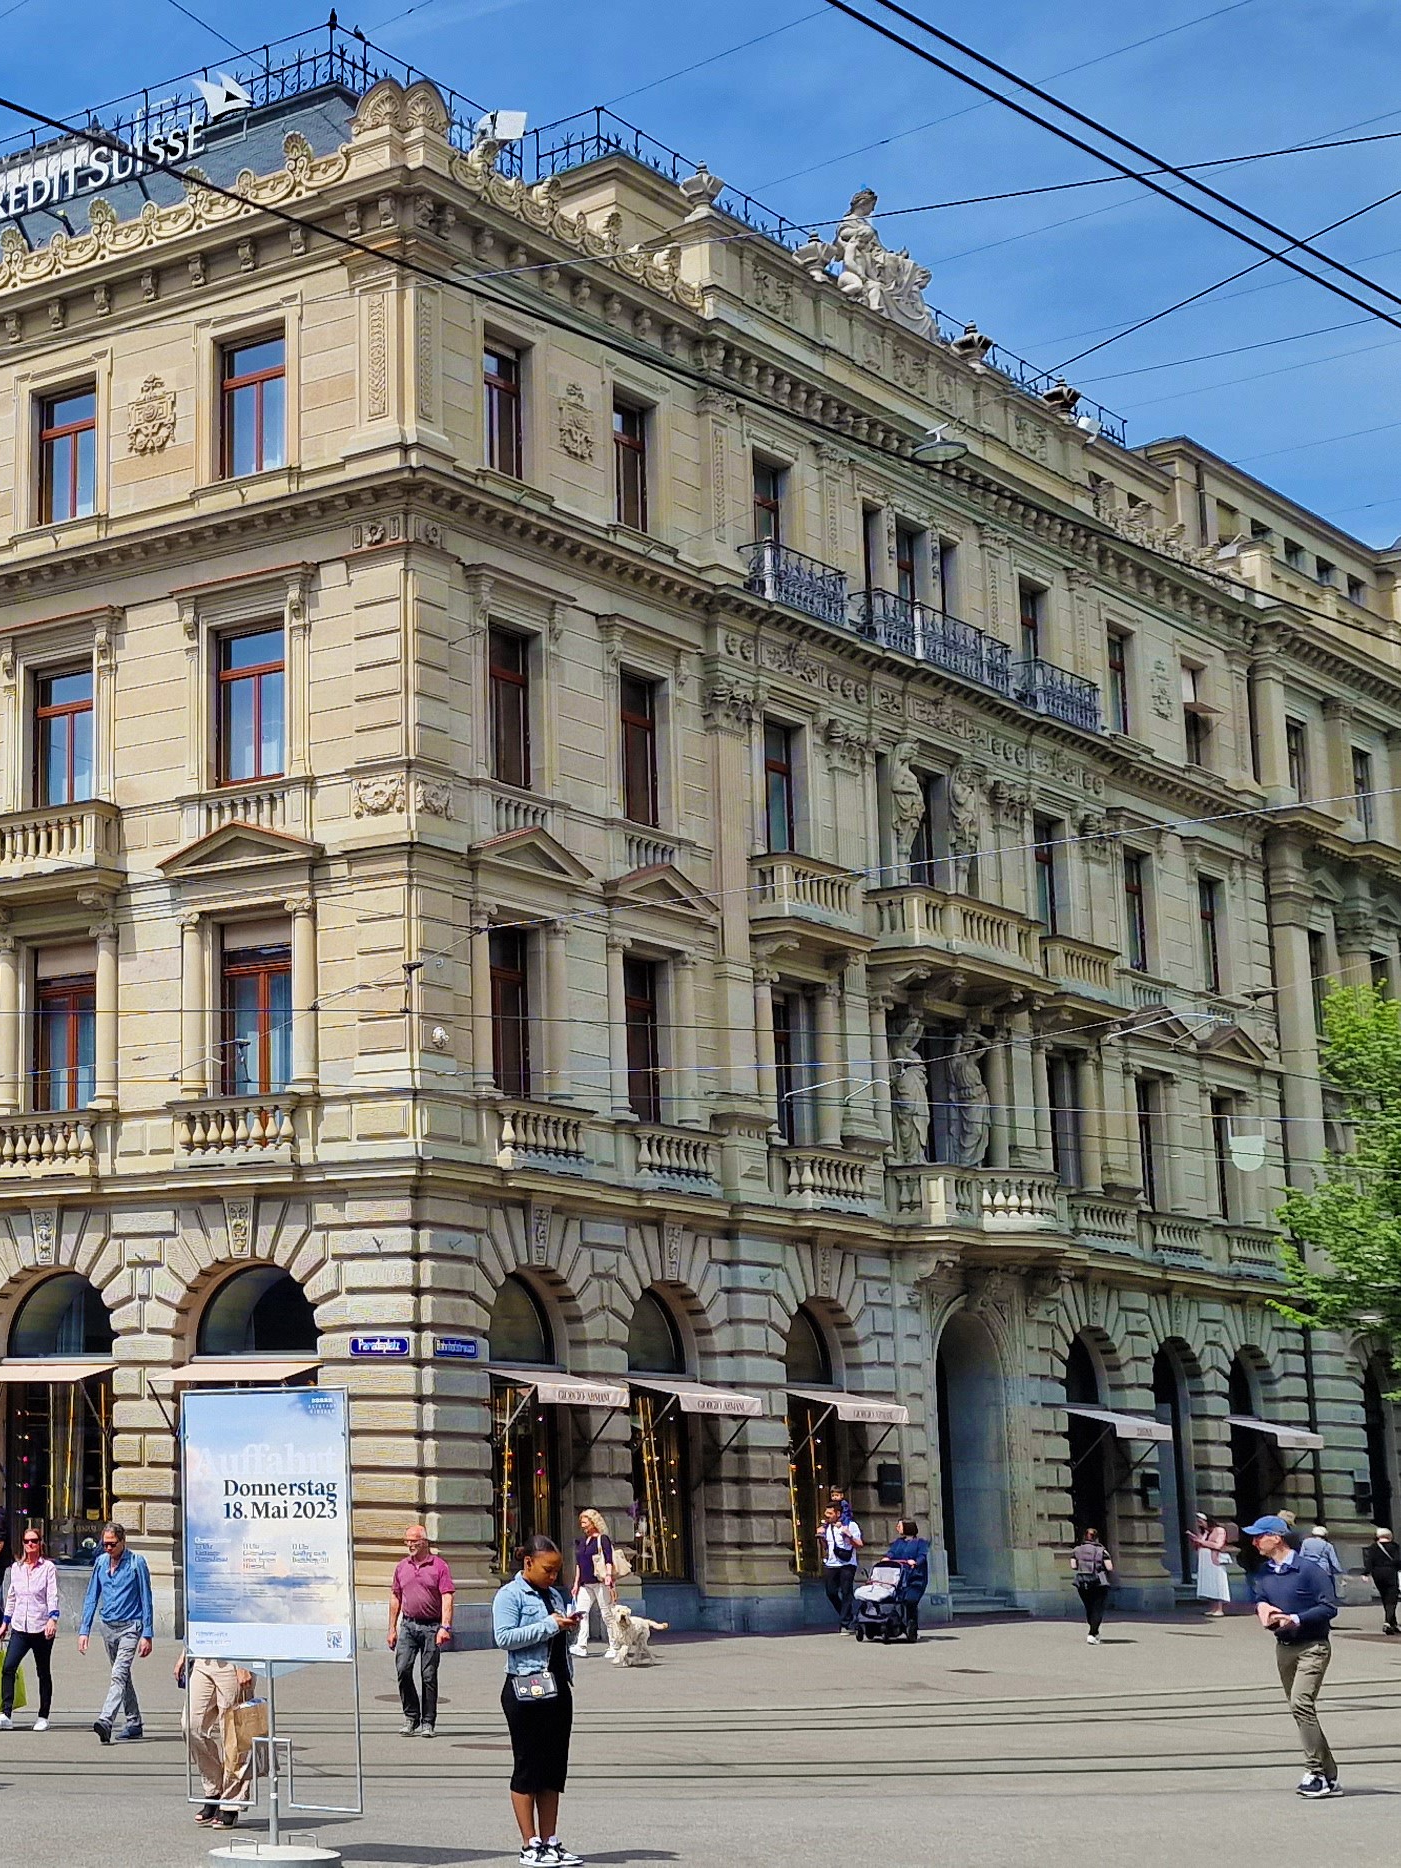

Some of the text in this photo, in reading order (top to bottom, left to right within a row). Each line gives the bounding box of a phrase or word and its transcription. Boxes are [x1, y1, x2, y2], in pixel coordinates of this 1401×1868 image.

[88, 111, 205, 188] SUISSE
[357, 1338, 401, 1354] Paradeplatz
[199, 1443, 338, 1475] Auffahrt
[223, 1479, 338, 1502] Donnerstag
[223, 1500, 338, 1519] 18. Mai 2023
